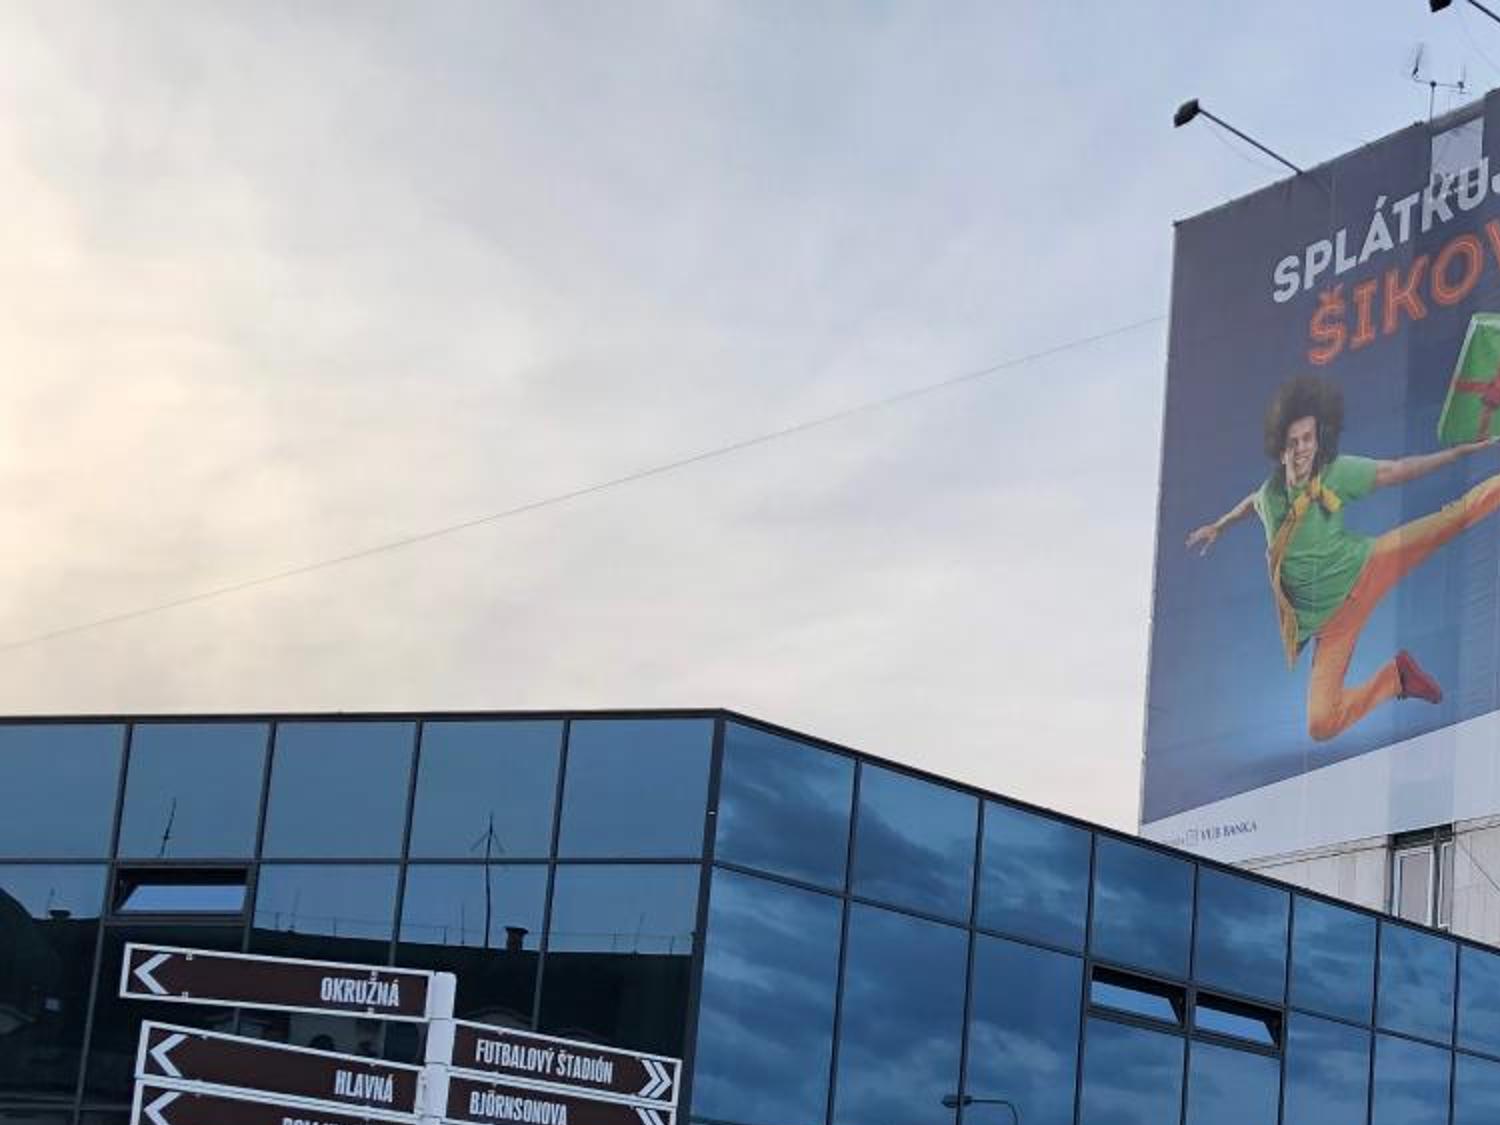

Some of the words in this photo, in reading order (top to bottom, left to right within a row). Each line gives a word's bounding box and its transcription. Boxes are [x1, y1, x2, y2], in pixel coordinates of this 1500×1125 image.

[321, 976, 399, 1007] OKRUŽNÁ
[475, 1038, 555, 1075] FUTBALOVÝ
[555, 1049, 614, 1084] ŠTADIÓN
[334, 1069, 394, 1103] HLAVNÁ
